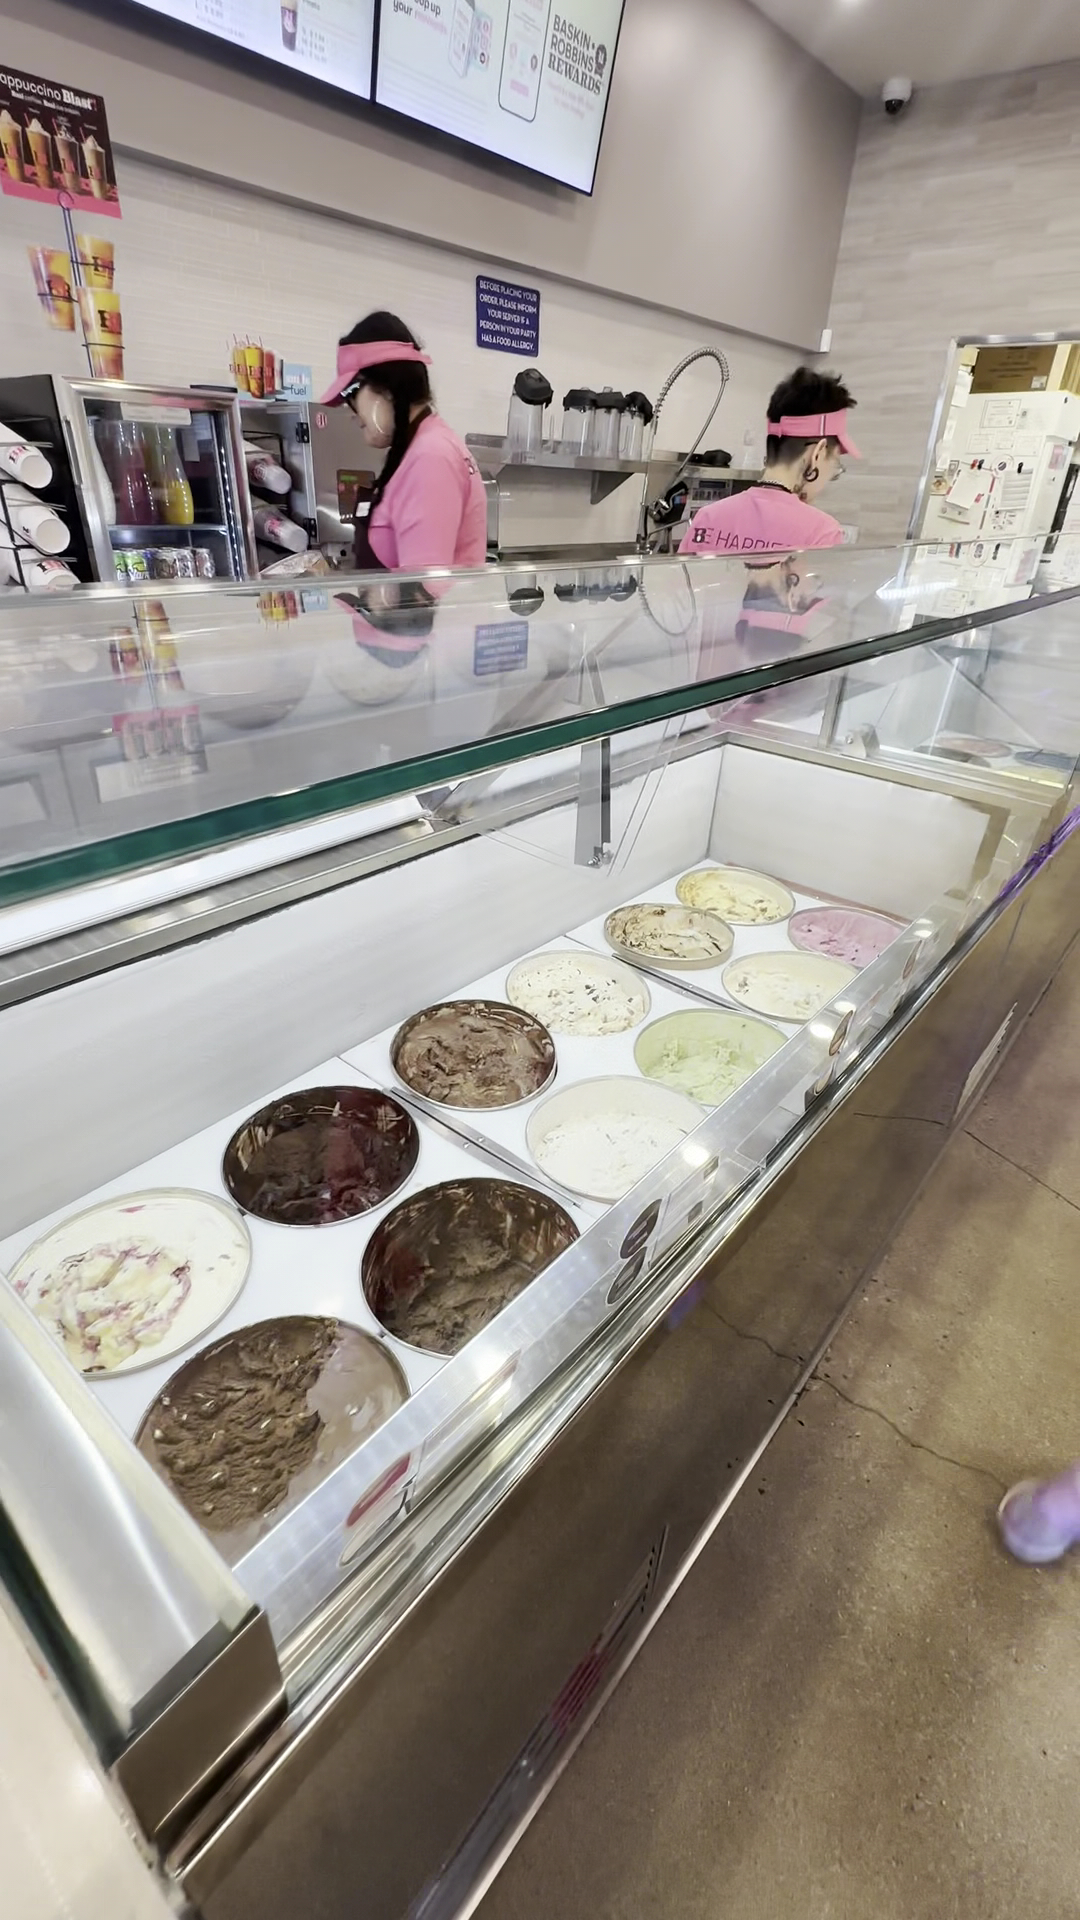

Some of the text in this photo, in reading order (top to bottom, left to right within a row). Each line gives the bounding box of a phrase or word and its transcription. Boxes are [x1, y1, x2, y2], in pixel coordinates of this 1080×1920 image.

[393, 0, 413, 16] your
[430, 2, 441, 17] up
[553, 14, 591, 52] BASKIN
[550, 33, 594, 73] ROBBINS
[547, 52, 602, 95] REWARDS
[479, 280, 538, 302] BEFORE PLACING YOUR
[499, 298, 517, 310] PLEASE
[517, 302, 537, 314] INFORM
[487, 308, 502, 319] YOUR
[502, 312, 521, 323] SERVER
[479, 319, 500, 331] PERSON
[505, 325, 520, 335] YOUR
[520, 328, 537, 339] PARTY
[481, 333, 493, 343] HAS
[497, 336, 511, 347] FOOD
[290, 384, 306, 396] fuel
[691, 527, 791, 550] BE HAPP
